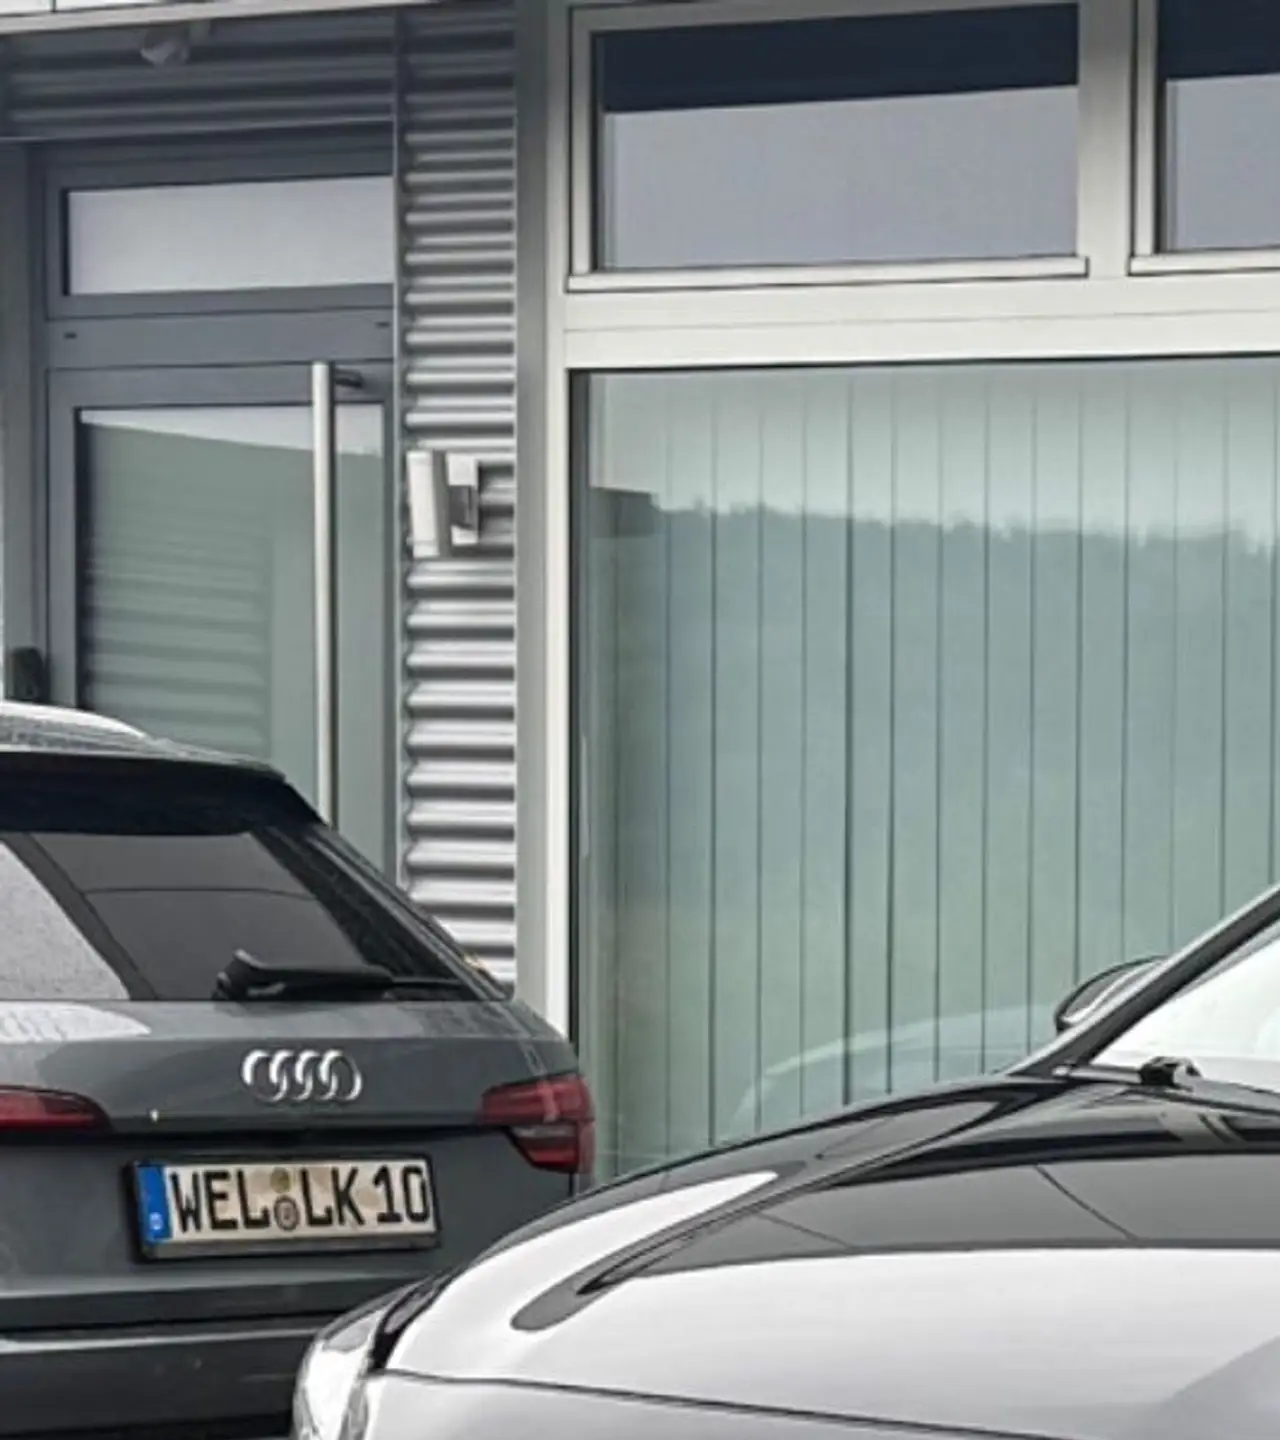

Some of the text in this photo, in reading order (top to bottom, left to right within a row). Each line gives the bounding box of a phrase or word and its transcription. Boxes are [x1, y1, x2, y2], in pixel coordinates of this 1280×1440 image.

[169, 1163, 431, 1234] WEL LK 10
